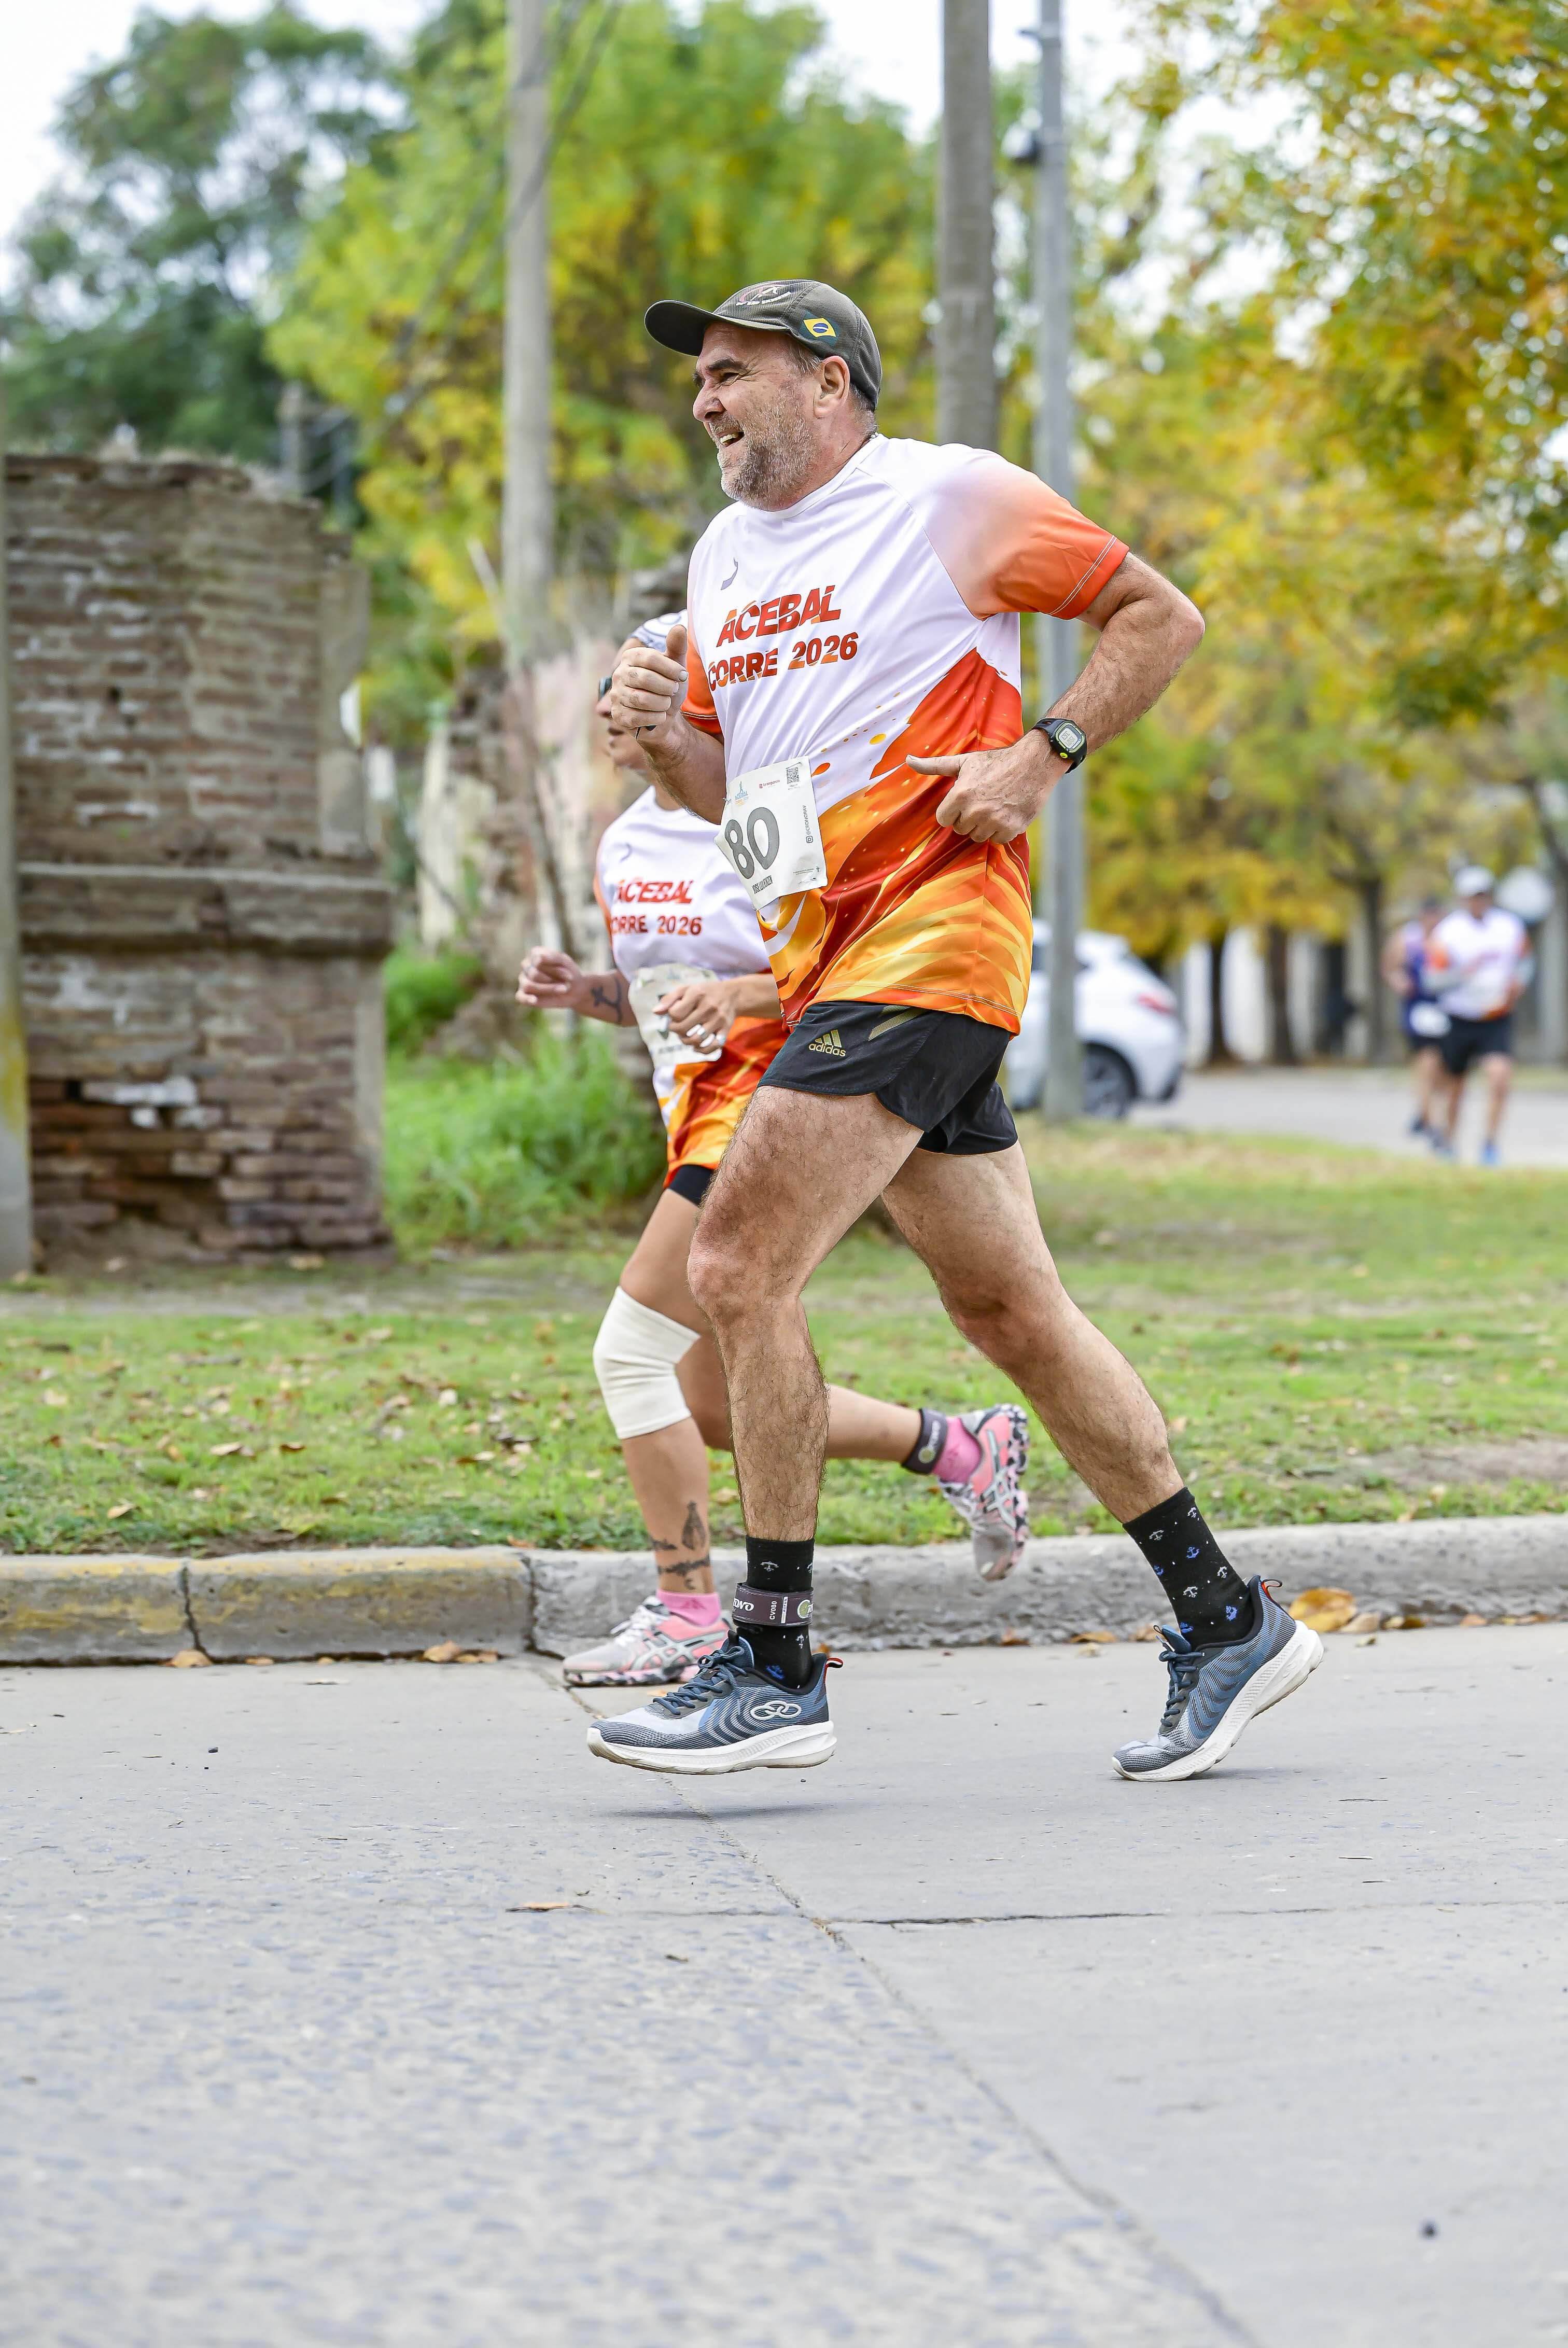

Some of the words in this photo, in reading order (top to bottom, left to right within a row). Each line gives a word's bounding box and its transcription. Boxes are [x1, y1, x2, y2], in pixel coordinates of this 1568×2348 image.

[716, 585, 841, 647] ACEBAL
[708, 648, 778, 691] CORRE
[788, 632, 859, 669] 2026
[724, 807, 780, 879] 80
[657, 915, 702, 935] 2026
[808, 1043, 847, 1057] adidas
